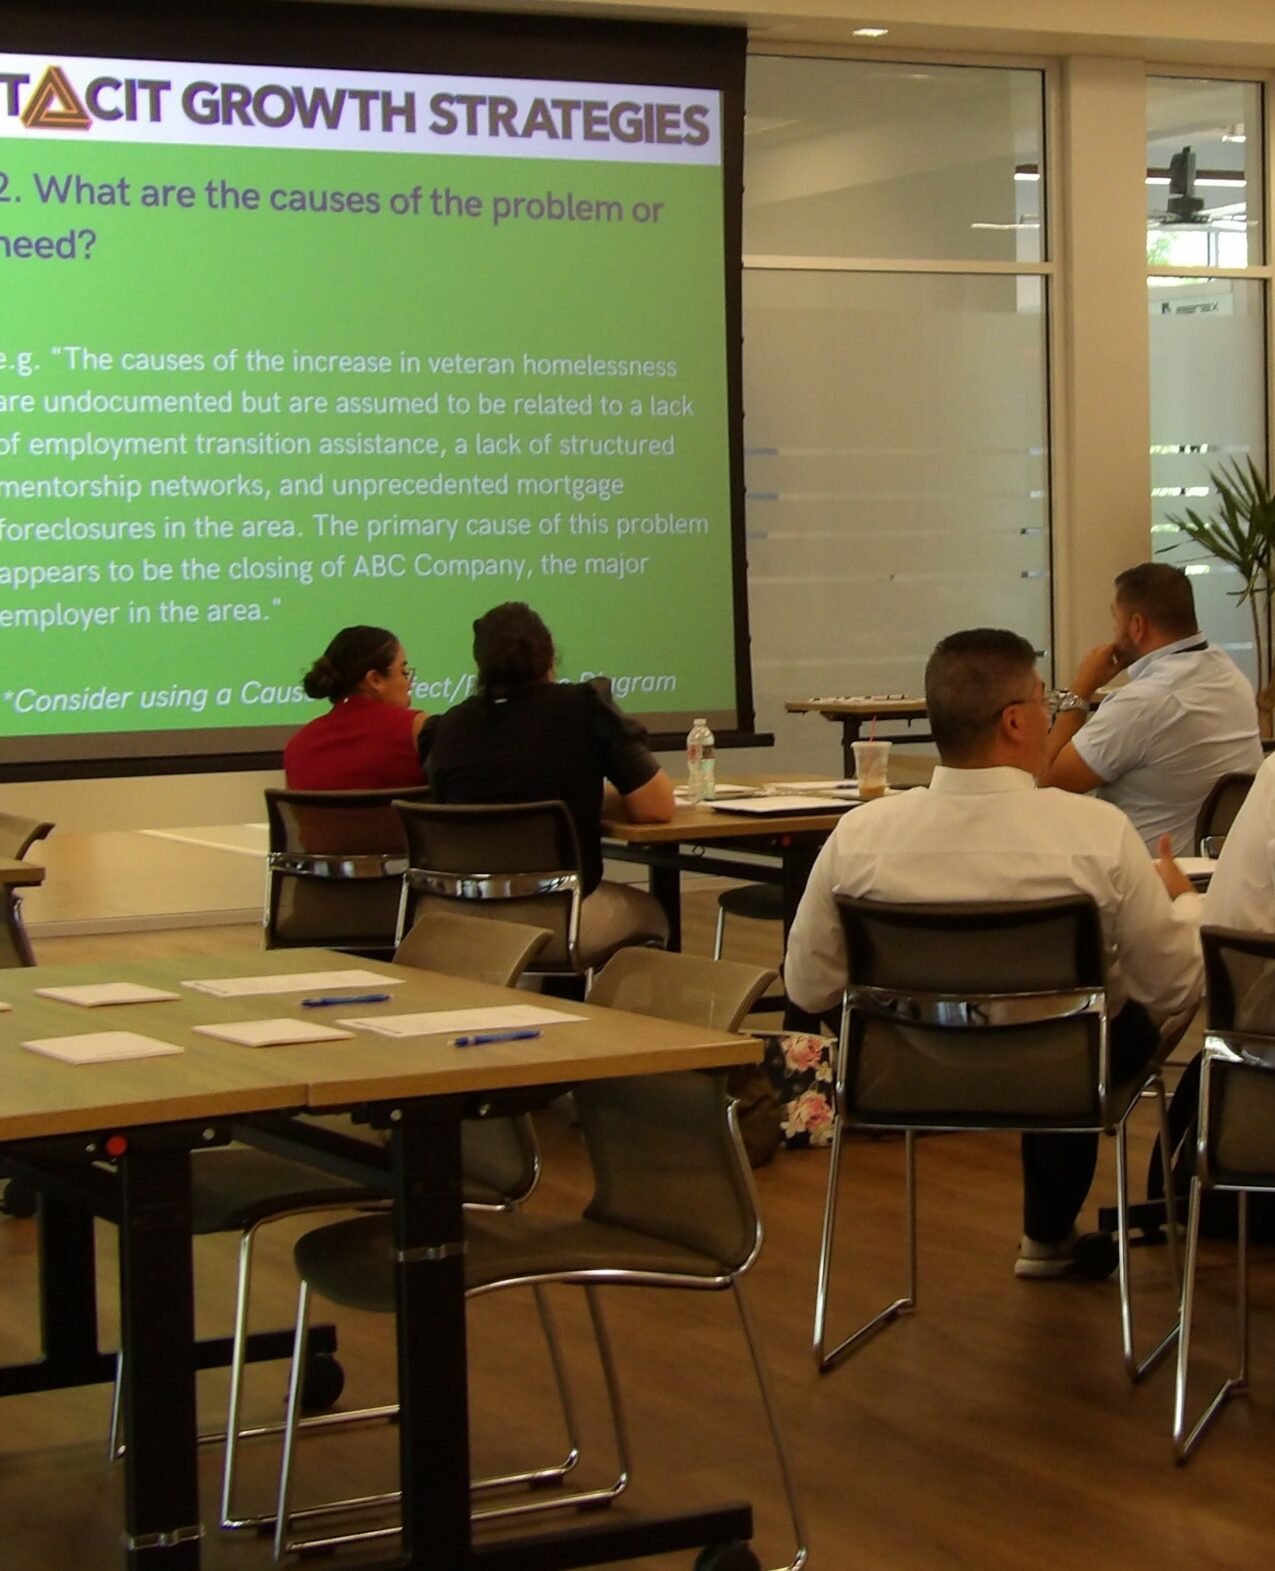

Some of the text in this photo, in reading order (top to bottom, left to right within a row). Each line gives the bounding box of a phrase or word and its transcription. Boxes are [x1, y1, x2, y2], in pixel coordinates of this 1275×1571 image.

[181, 80, 417, 133] GROWTH
[429, 92, 711, 146] STRATEGIES
[33, 172, 130, 206] What
[141, 183, 196, 208] are
[205, 179, 260, 210] the
[270, 188, 380, 214] causes
[390, 186, 422, 215] of
[431, 187, 482, 217] the
[493, 191, 623, 226] problem
[632, 200, 665, 223] or
[0, 229, 97, 260] need?
[51, 346, 113, 371] "The
[121, 353, 205, 373] causes
[213, 349, 239, 373] of
[245, 349, 285, 373] the
[293, 350, 392, 374] increase
[400, 351, 421, 374] in
[428, 353, 515, 376] veteran
[522, 353, 677, 377] homelessness
[0, 389, 695, 417] are undocumented but are assumed to be related to a lack
[0, 432, 675, 461] of employment transition assistance, a lack of structured
[0, 474, 624, 502] mentorship networks, and unprecedented mortgage
[0, 513, 709, 541] foreclosures in the area. The primary cause of this problem
[0, 553, 649, 590] appears to be the closing of ABC Company, the major
[0, 598, 282, 632] employer in the area."
[140, 684, 208, 711] using
[216, 686, 231, 706] a
